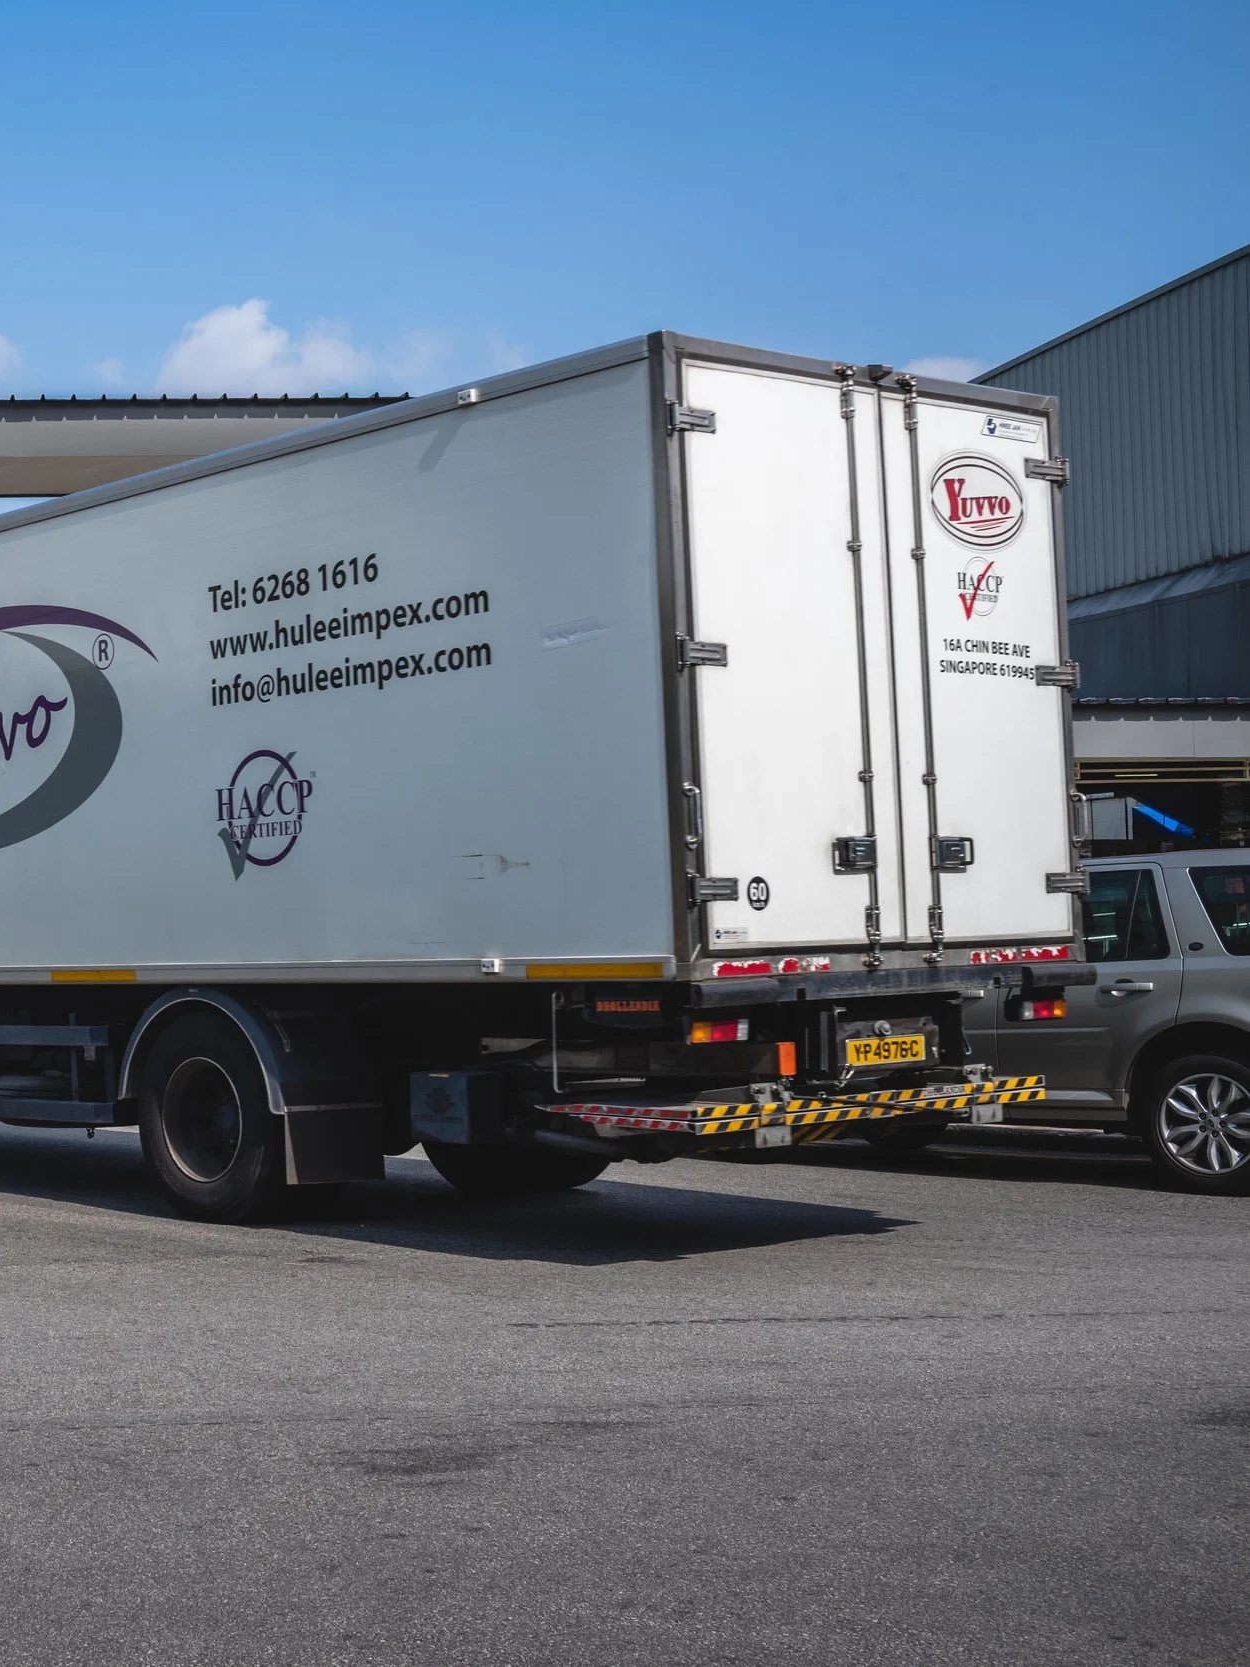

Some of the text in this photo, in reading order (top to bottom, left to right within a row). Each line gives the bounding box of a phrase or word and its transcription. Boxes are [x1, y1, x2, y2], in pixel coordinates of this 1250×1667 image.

[208, 553, 378, 612] Tel: 6268 1616
[957, 572, 1002, 593] HACCP
[210, 589, 489, 659] www.huleeimpex.com
[943, 638, 1030, 658] 16A CHIN BEE AVE
[211, 642, 491, 706] info@huleeimpex.com
[940, 659, 1034, 680] SINGAPORE 619945
[215, 779, 313, 821] HACCP
[230, 820, 303, 840] CERTIFIED
[749, 883, 768, 900] 60
